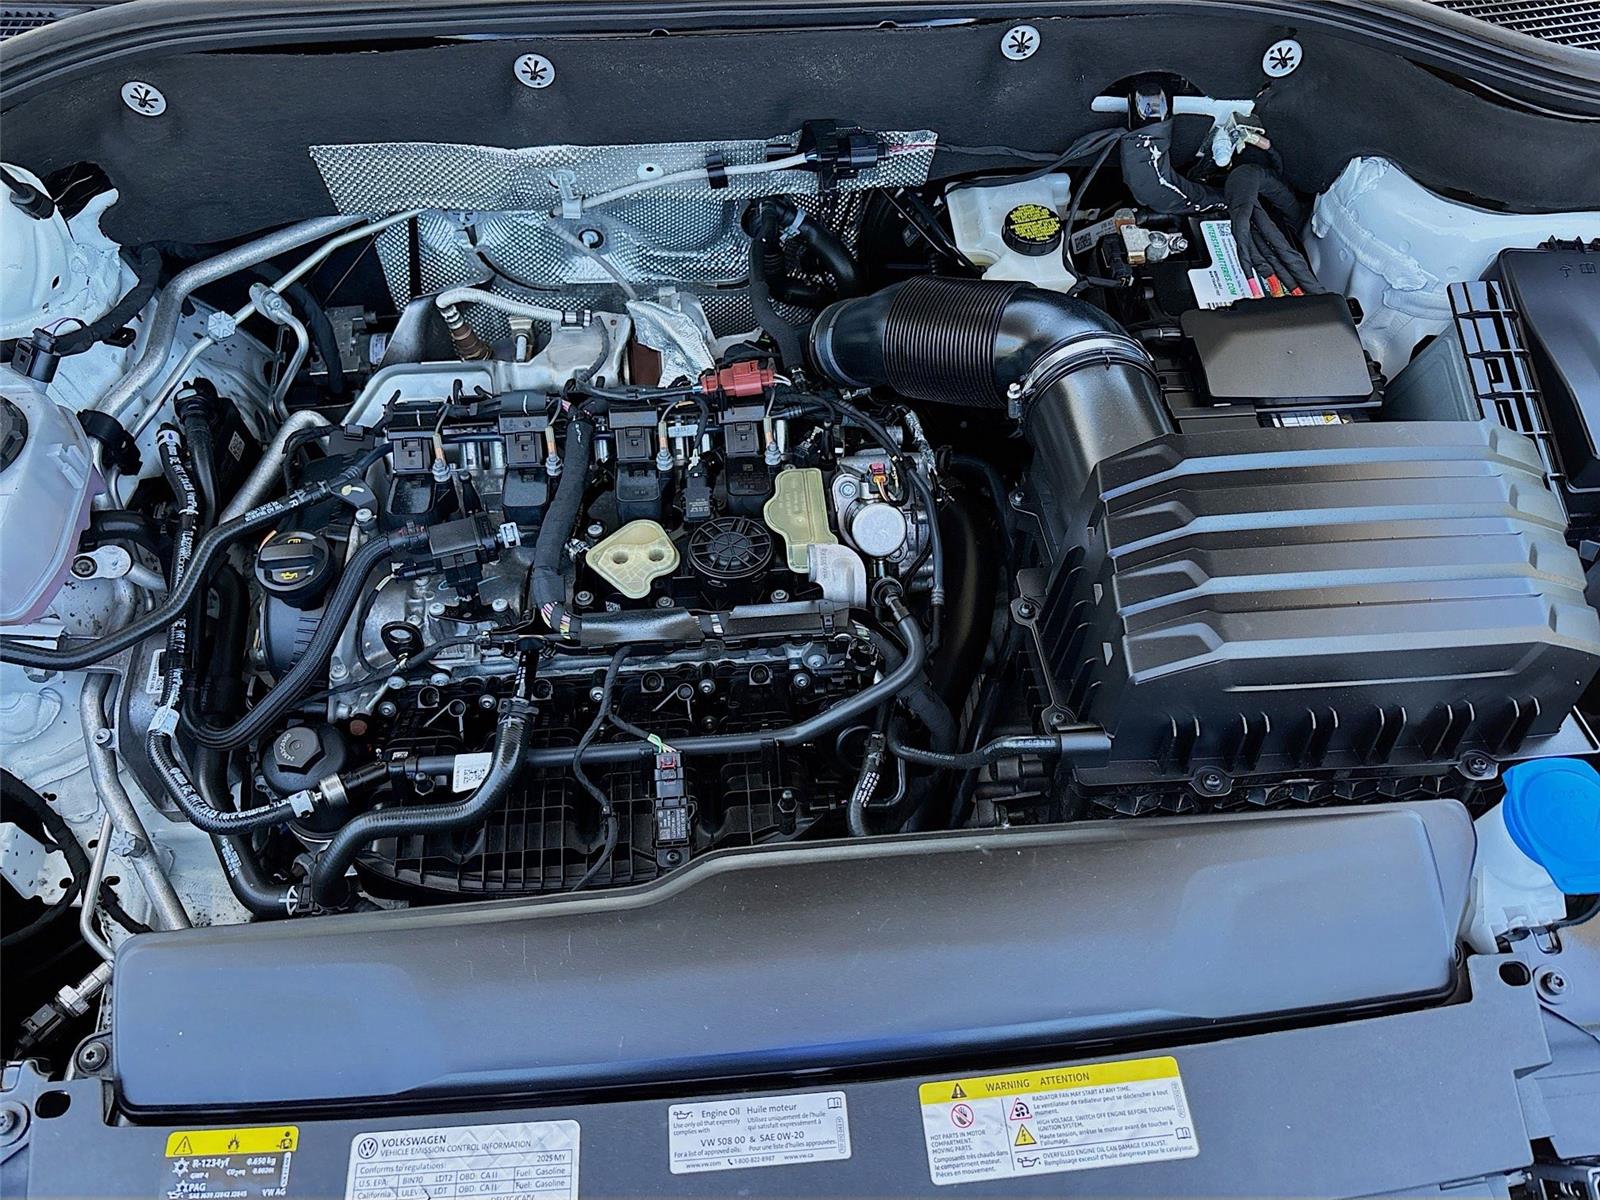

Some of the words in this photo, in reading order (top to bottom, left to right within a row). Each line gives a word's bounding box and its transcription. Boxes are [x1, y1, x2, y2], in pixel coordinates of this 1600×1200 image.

[986, 1080, 1030, 1091] WARNING
[1039, 1073, 1090, 1085] ATTENTION
[701, 1109, 728, 1120] Engine
[747, 1105, 767, 1114] Huile
[769, 1104, 797, 1112] moteur
[382, 1135, 447, 1147] VOLKSWAGEN
[717, 1137, 733, 1145] 508
[760, 1134, 775, 1142] SAE
[777, 1131, 804, 1140] 0W-20
[381, 1148, 408, 1157] VEHICLE
[411, 1145, 445, 1155] EMISSION
[447, 1143, 480, 1152] CONTROL
[482, 1140, 531, 1150] INFORMATION
[192, 1158, 230, 1170] R-1234yf
[360, 1165, 394, 1174] Conforms
[536, 1167, 565, 1176] Gasoline
[189, 1183, 206, 1192] PAG
[535, 1179, 565, 1188] Gasoline
